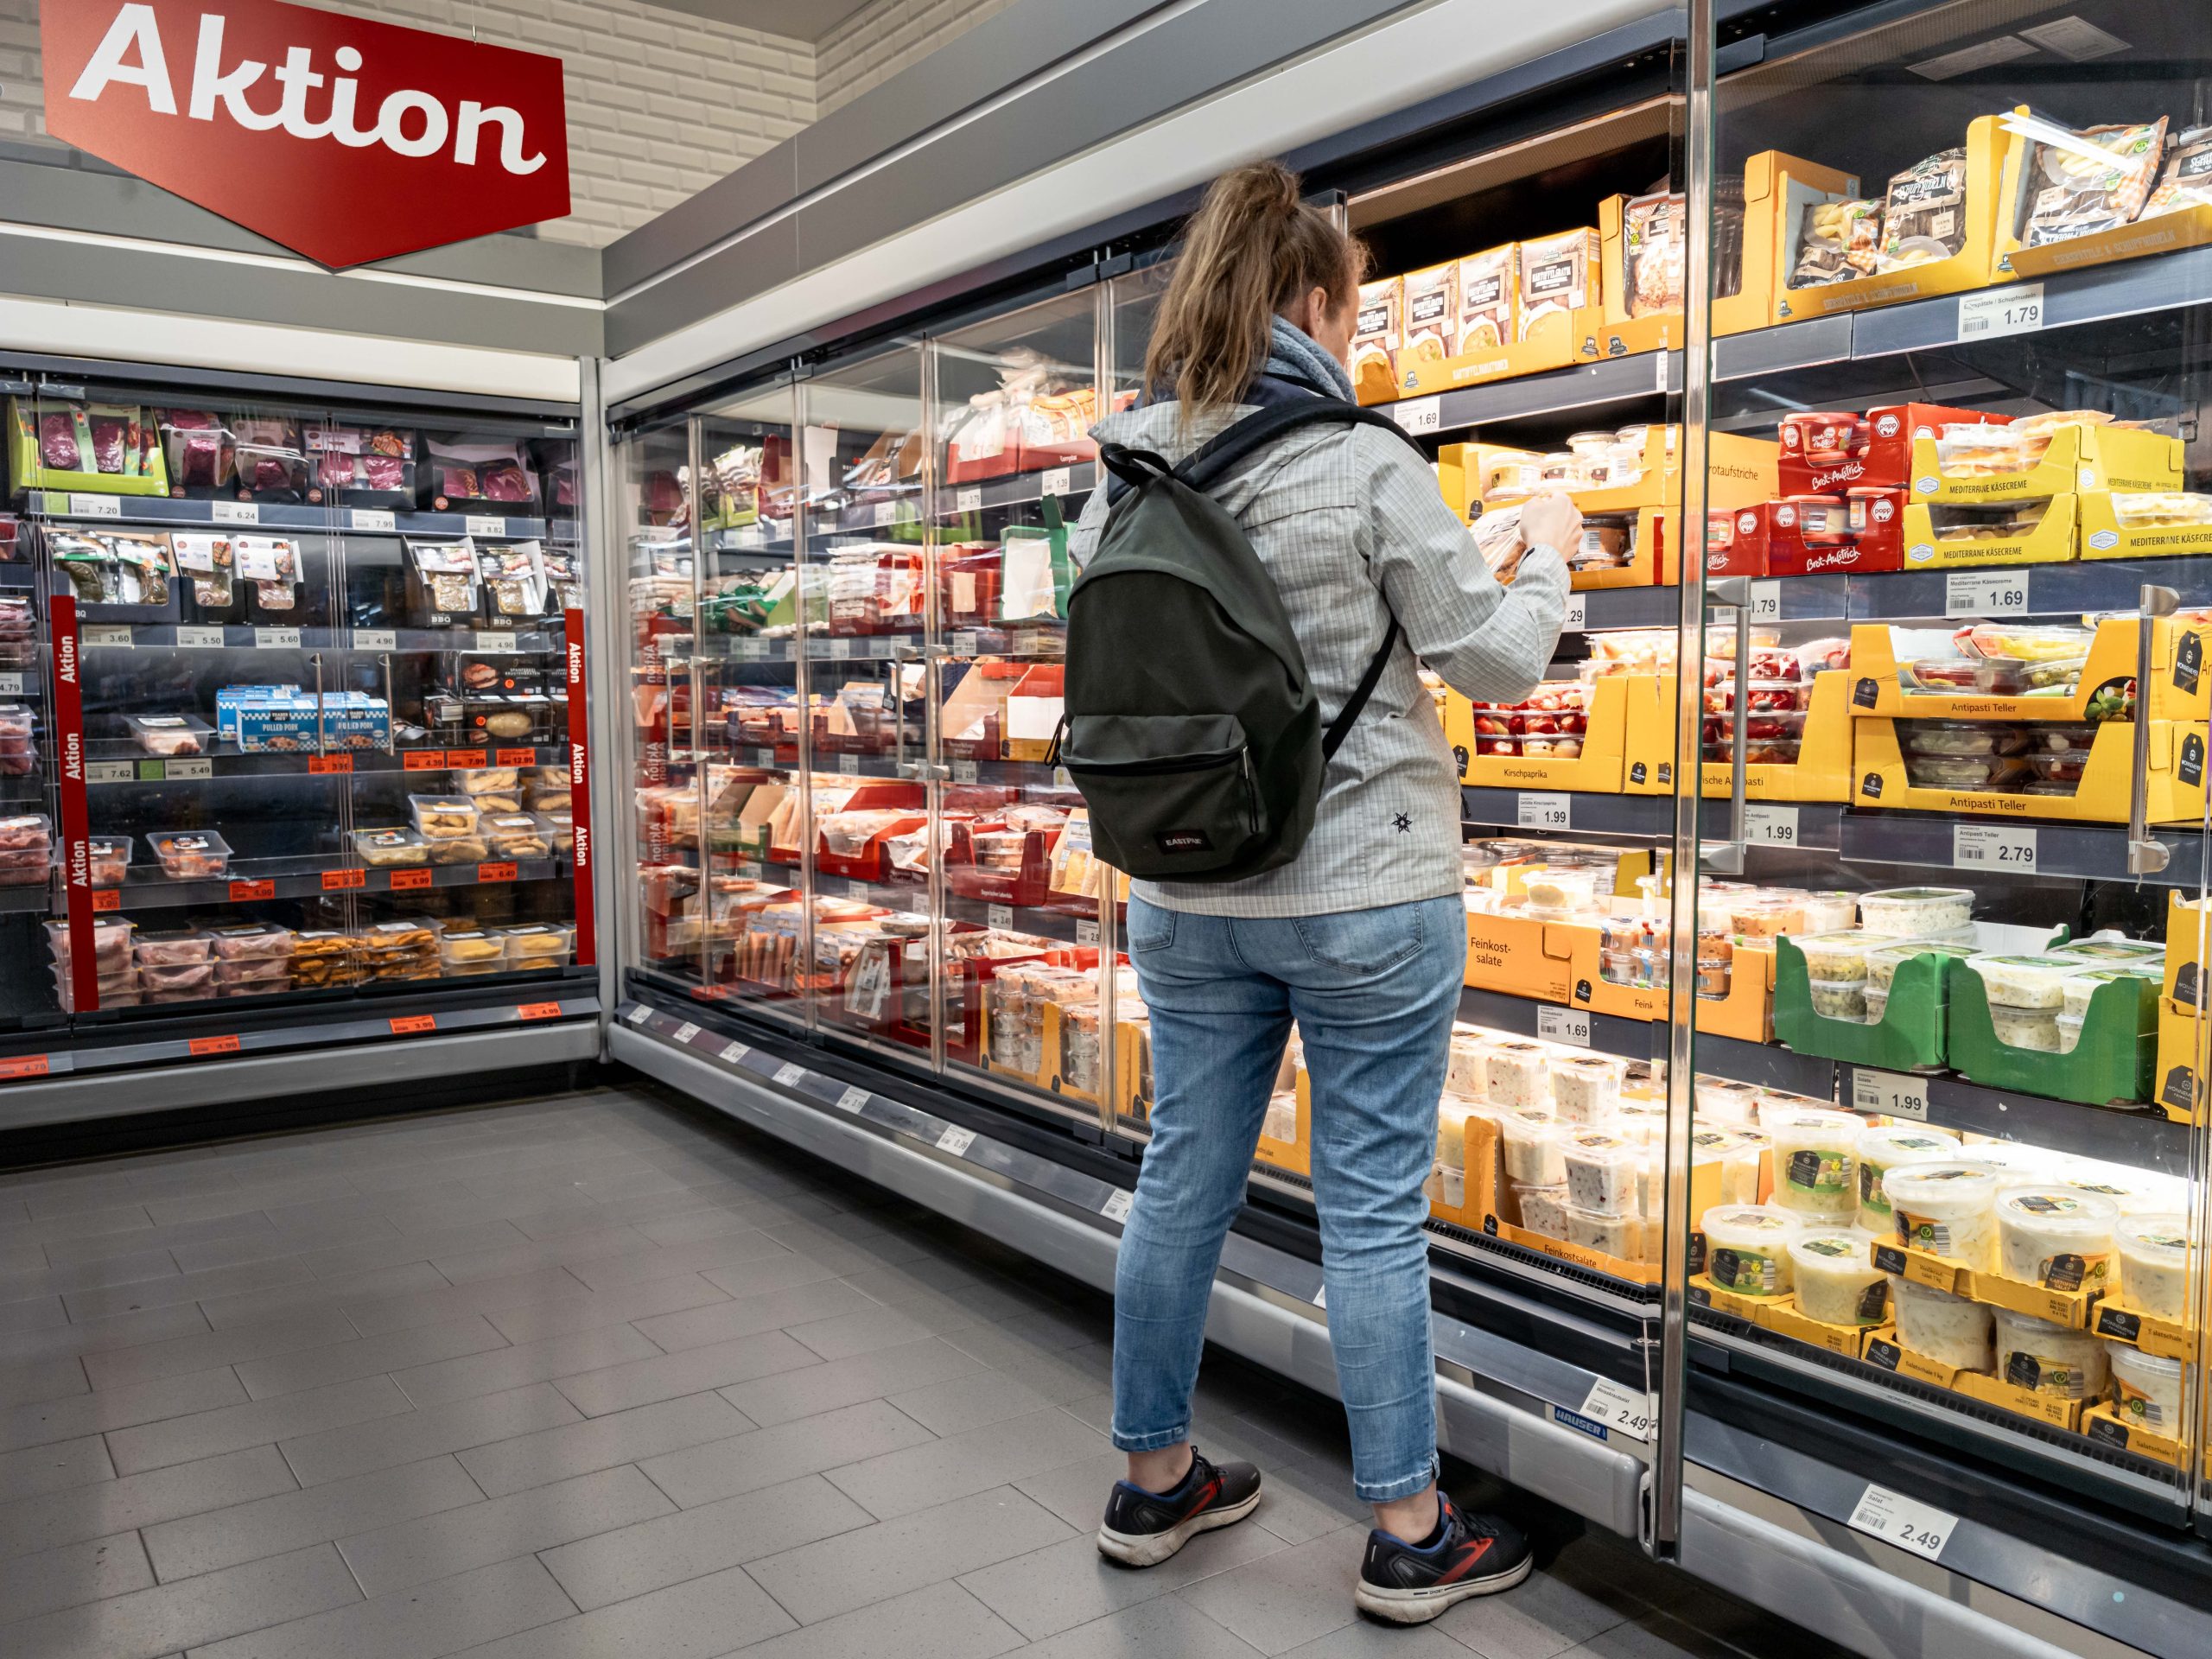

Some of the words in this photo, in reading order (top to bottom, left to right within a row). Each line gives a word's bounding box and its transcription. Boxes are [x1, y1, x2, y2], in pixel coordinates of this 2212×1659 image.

[69, 2, 548, 175] Aktion
[1998, 293, 2037, 304] Schupfnudeln
[2004, 305, 2038, 325] 1.79
[1419, 412, 1437, 426] 1.69
[1708, 464, 1759, 480] rotaufstriche
[1949, 484, 1990, 494] MEDITERRANE
[1991, 480, 2027, 492] KÄSECREME
[98, 506, 118, 515] 7.20
[237, 512, 256, 520] 6.24
[1875, 506, 1891, 515] popp
[375, 520, 393, 529] 7.99
[2130, 536, 2179, 547] MEDITERRANE
[1944, 549, 1986, 559] MEDITERRANE
[1986, 546, 2023, 557] KÄSECREME
[1990, 591, 2024, 606] 1.69
[1751, 599, 1777, 613] 1.79
[1567, 610, 1583, 622] .29
[110, 634, 130, 643] 3.60
[202, 636, 222, 645] 5.50
[280, 635, 299, 644] 5.60
[376, 637, 394, 645] 4.90
[60, 635, 76, 683] Aktion
[569, 642, 582, 683] Aktion
[0, 683, 20, 692] 4.79
[1951, 702, 1991, 713] Antipasti
[1993, 702, 2017, 713] Teller
[66, 733, 81, 779] Aktion
[426, 759, 442, 767] 4.39
[191, 766, 210, 775] 5.49
[573, 742, 585, 785] Aktion
[111, 769, 131, 778] 7.62
[1503, 768, 1548, 779] Kirschpaprika
[1702, 775, 1723, 785] ische
[1725, 776, 1764, 786] Apasti
[1950, 797, 1996, 810] Antipasti
[1998, 799, 2026, 811] Teller
[1544, 810, 1567, 823] 1.99
[1765, 825, 1793, 840] 1.99
[575, 826, 588, 867] Aktion
[1165, 837, 1202, 846] EASTPAK
[1999, 845, 2033, 861] 2.79
[73, 840, 88, 887] Aktion
[1090, 932, 1100, 942] 2.9
[1471, 937, 1511, 953] Feinkost-
[1476, 953, 1503, 967] salate
[1566, 1023, 1587, 1037] 1.69
[1892, 1093, 1922, 1110] 1.99
[1544, 1244, 1597, 1268] Feinkostsalate
[1555, 1409, 1602, 1435] HAUSER
[1617, 1409, 1649, 1431] 2.49
[1867, 1494, 1883, 1504] Salat
[1899, 1524, 1941, 1549] 2.49
